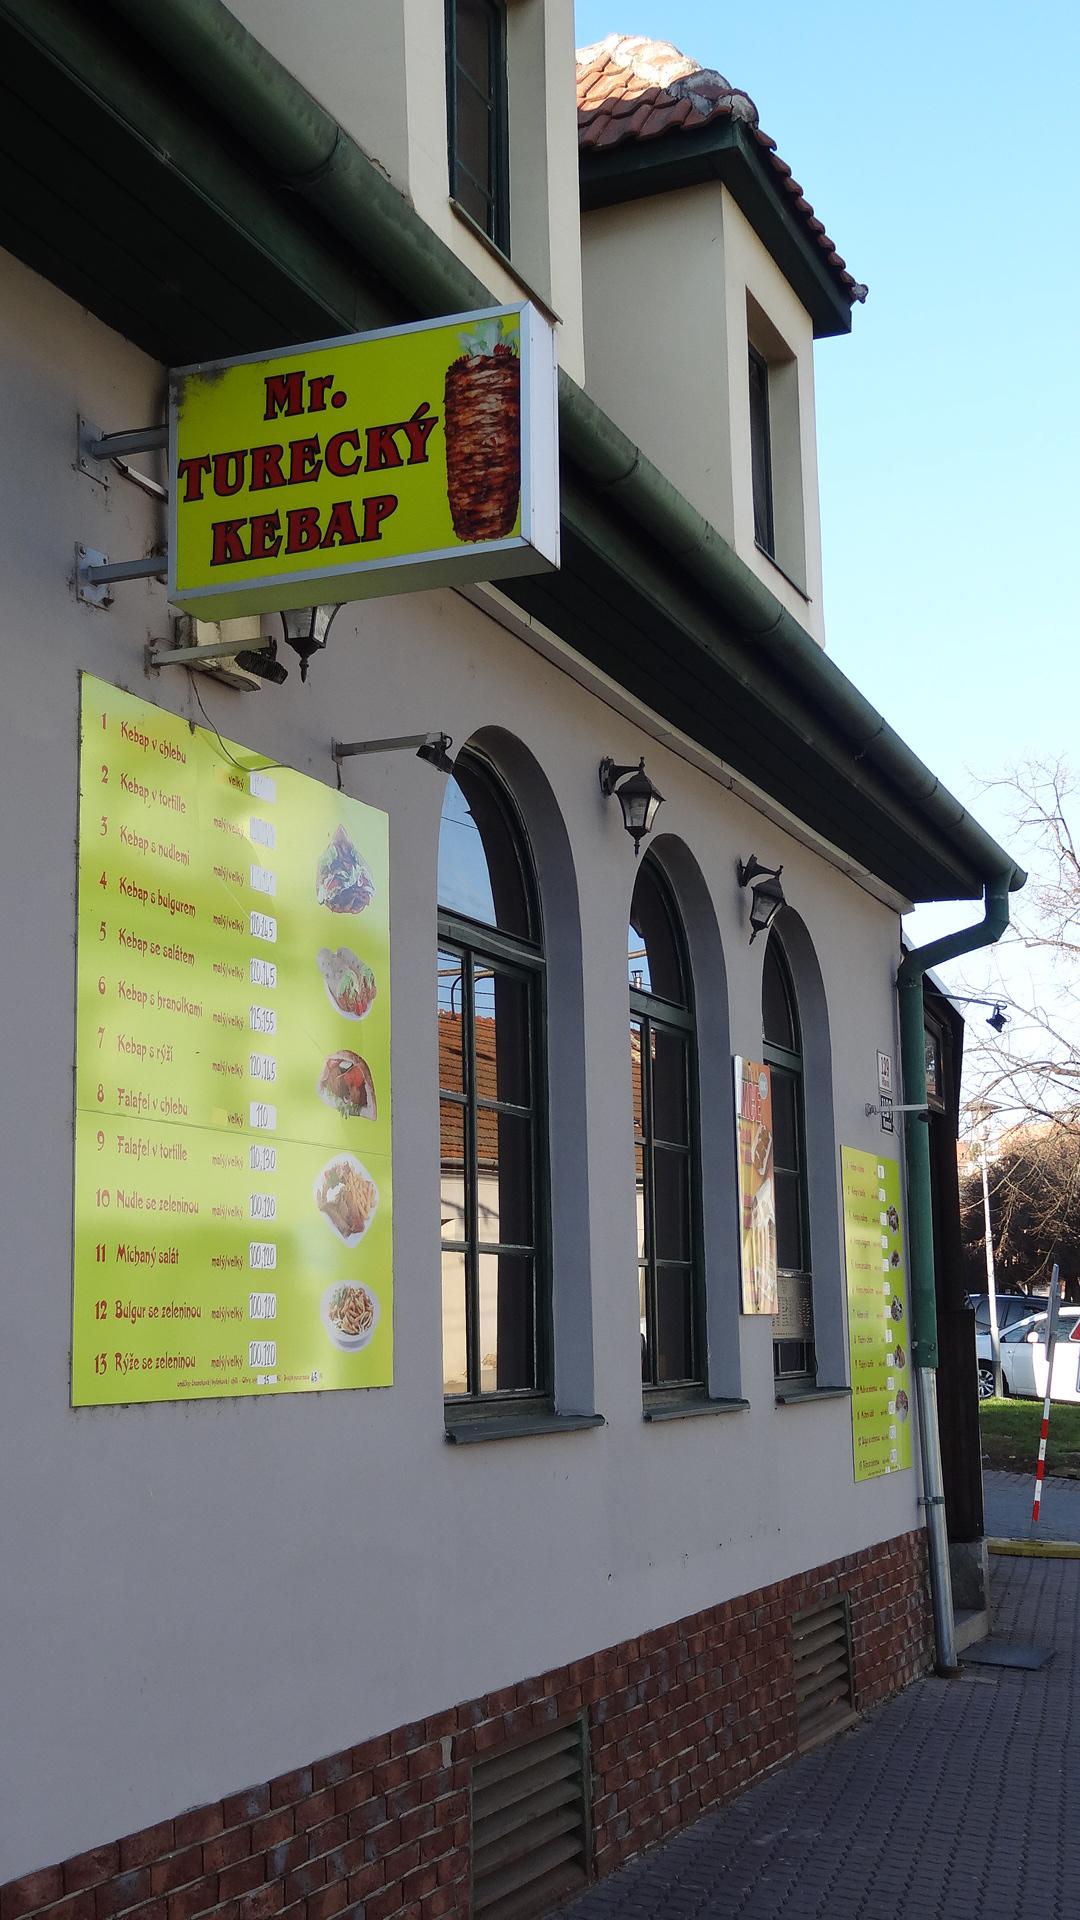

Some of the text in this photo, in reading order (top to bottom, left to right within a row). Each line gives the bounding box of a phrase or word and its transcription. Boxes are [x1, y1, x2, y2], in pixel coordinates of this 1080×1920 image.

[264, 370, 347, 420] Mr.
[178, 402, 438, 502] TURECKÝ
[210, 494, 398, 566] KEBAP
[102, 713, 106, 730] 1
[120, 721, 150, 752] Kebap
[152, 740, 157, 750] v
[160, 740, 186, 764] chlebu
[228, 775, 244, 791] velký
[102, 765, 108, 784] 2
[120, 773, 149, 803] Kebap
[152, 790, 157, 800] v
[160, 790, 186, 814] tortille
[100, 816, 108, 836] 3
[120, 824, 148, 855] Kebap
[152, 841, 156, 853] s
[158, 844, 190, 866] nudlemi
[100, 872, 107, 889] 4
[120, 877, 148, 906] Kebap
[150, 892, 156, 904] s
[158, 889, 196, 918] bulgurem
[100, 922, 106, 941] 5
[119, 928, 148, 957] Kebap
[150, 942, 160, 955] se
[163, 944, 194, 966] salátem
[98, 976, 106, 994] 6
[118, 981, 147, 1010] Kebap
[150, 995, 154, 1006] s
[158, 992, 202, 1018] hranolkami
[98, 1027, 105, 1048] 7
[118, 1034, 146, 1062] Kebap
[150, 1048, 154, 1058] s
[157, 1044, 172, 1064] rýží
[97, 1084, 104, 1102] 8
[118, 1088, 150, 1114] Falafel
[153, 1102, 158, 1110] v
[160, 1099, 188, 1117] chlebu
[228, 1113, 244, 1128] velký
[97, 1130, 104, 1151] 9
[117, 1136, 150, 1160] Falafel
[152, 1146, 158, 1156] v
[160, 1144, 188, 1161] tortille
[96, 1188, 110, 1208] 10
[117, 1190, 144, 1210] Nudle
[146, 1199, 156, 1210] se
[159, 1195, 198, 1215] zeleninou
[96, 1244, 106, 1262] 11
[116, 1244, 156, 1268] Míchaný
[159, 1248, 180, 1264] salát
[95, 1300, 108, 1320] 12
[115, 1300, 146, 1324] Bulgur
[149, 1307, 159, 1318] se
[161, 1303, 202, 1320] zeleninou
[95, 1353, 108, 1375] 13
[115, 1352, 140, 1375] Rýže
[142, 1358, 153, 1370] se
[156, 1352, 196, 1371] zeleninou
